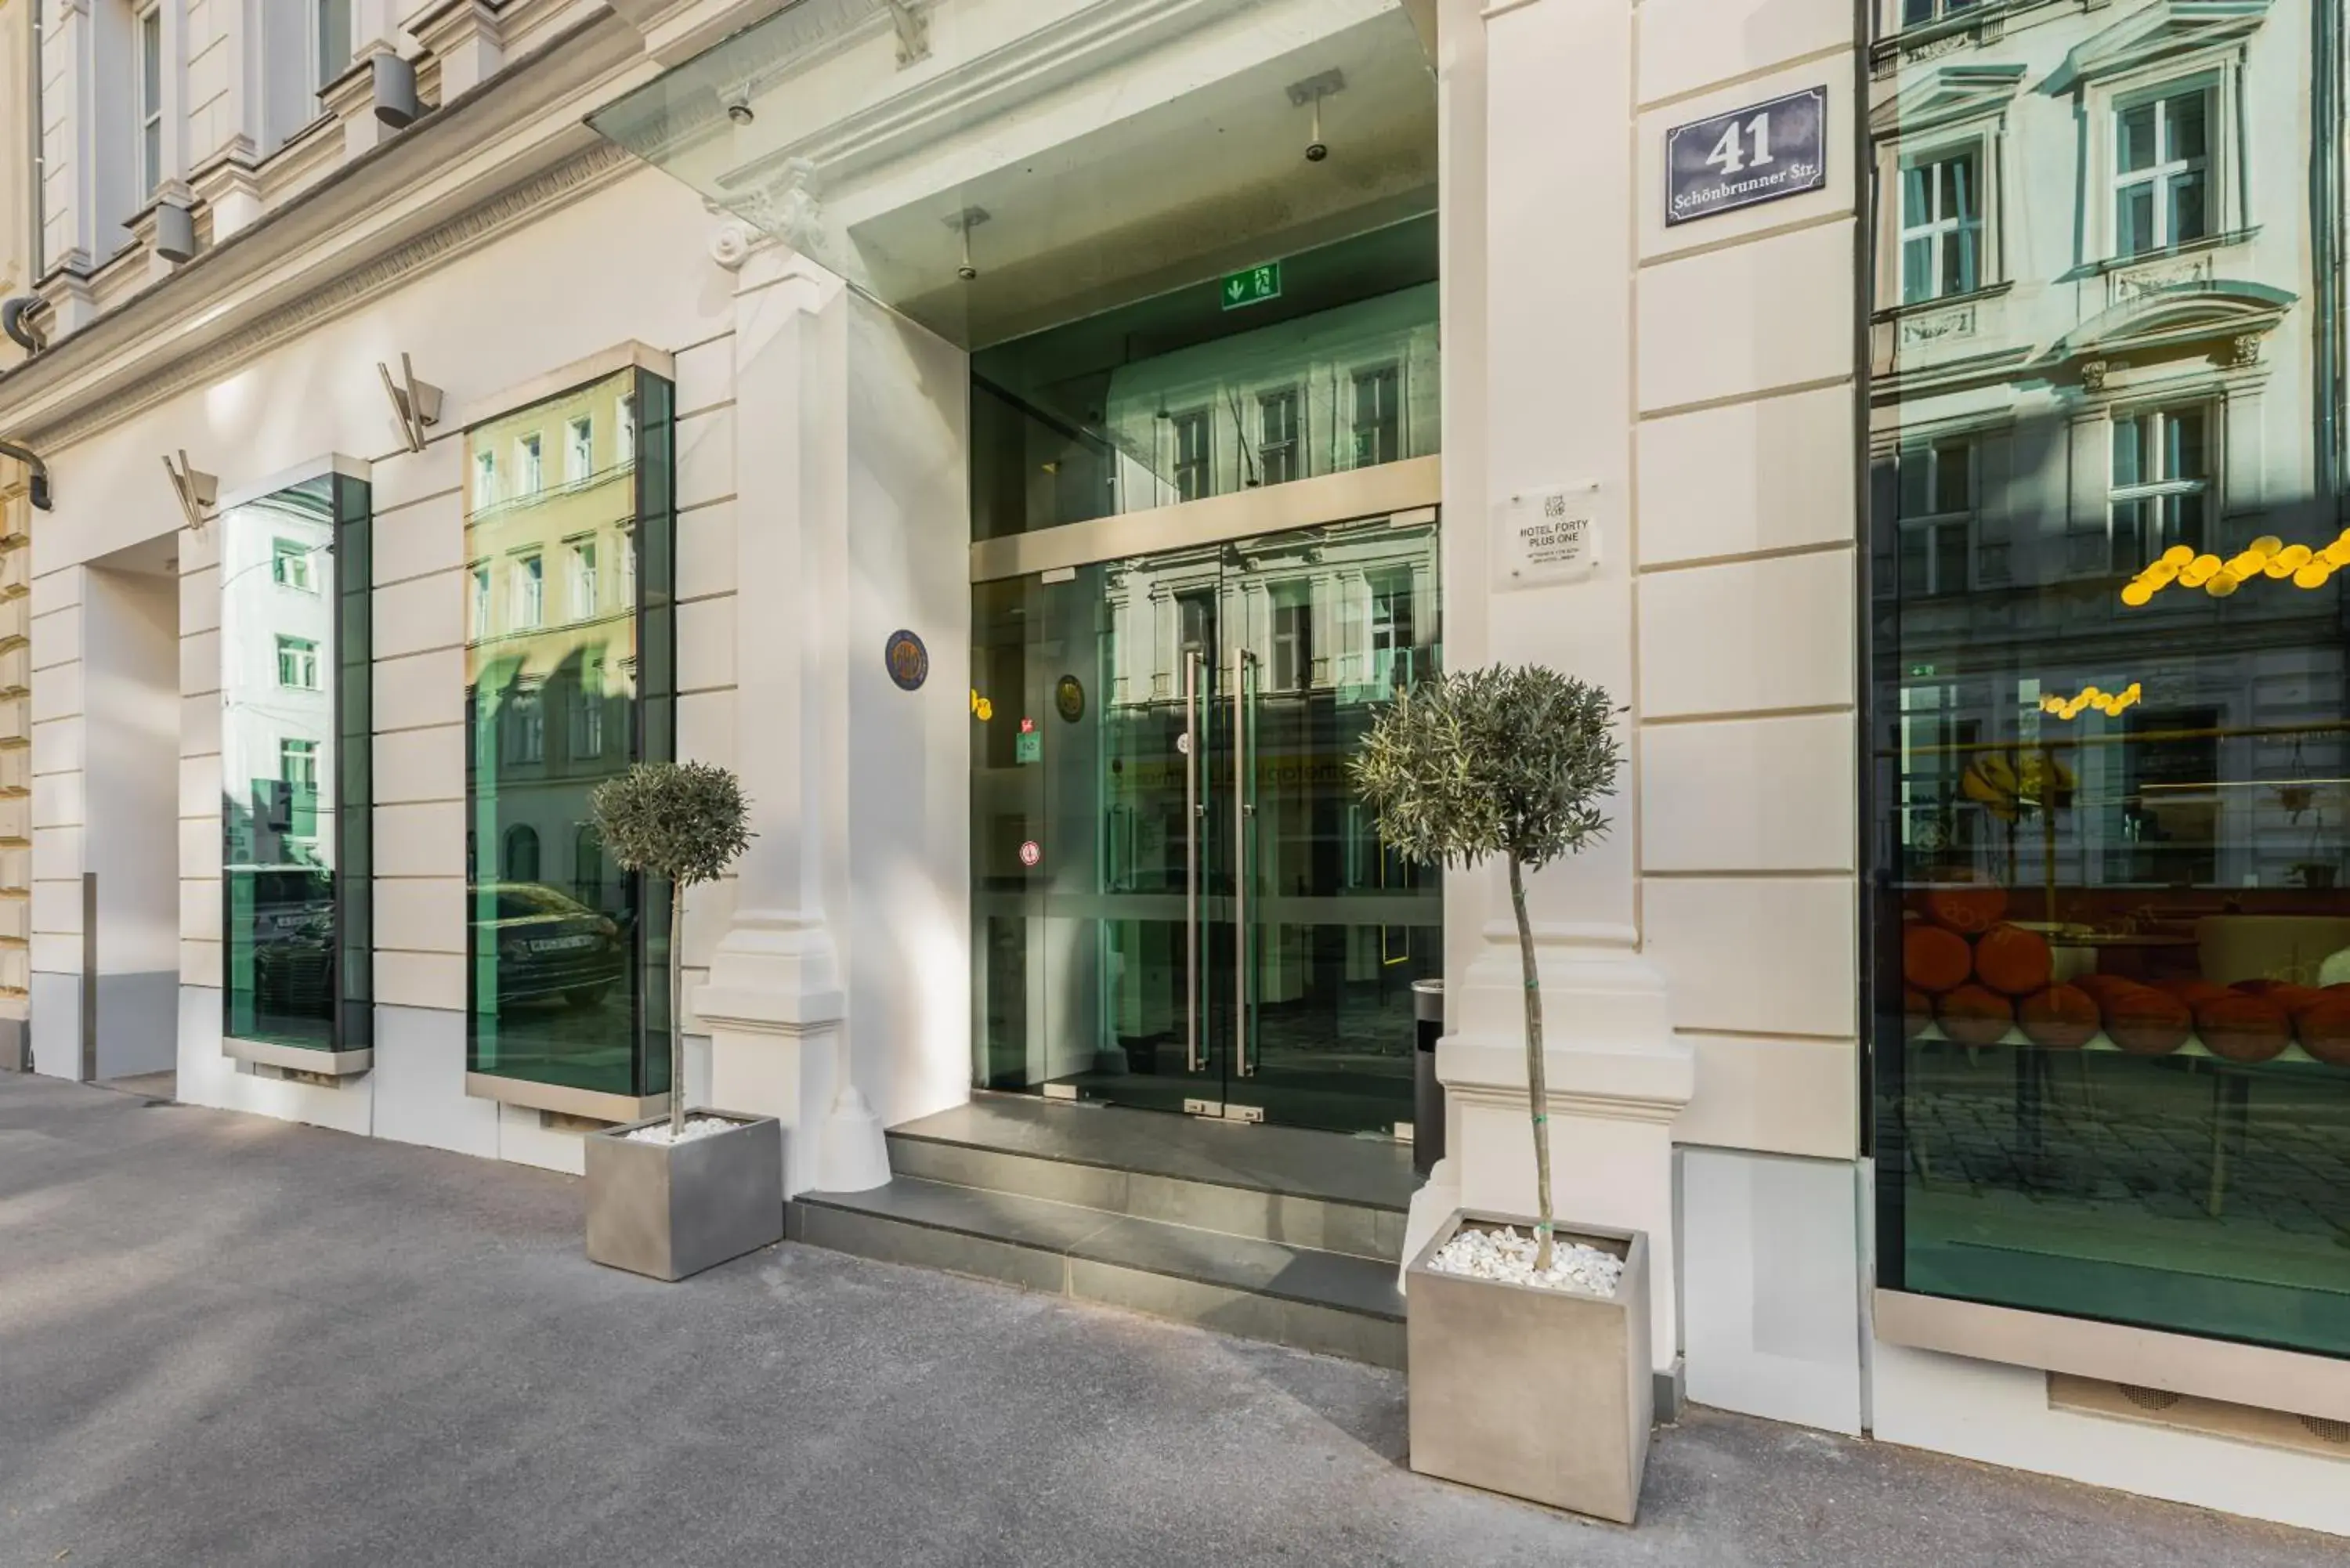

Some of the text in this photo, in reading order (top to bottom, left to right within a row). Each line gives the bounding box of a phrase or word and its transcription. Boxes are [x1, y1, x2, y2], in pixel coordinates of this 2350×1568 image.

[1705, 112, 1774, 175] 41
[1674, 163, 1817, 210] Schönbrunner Str.
[1520, 520, 1588, 537] HOTEL FORTY
[1529, 532, 1578, 547] PLUS ONE
